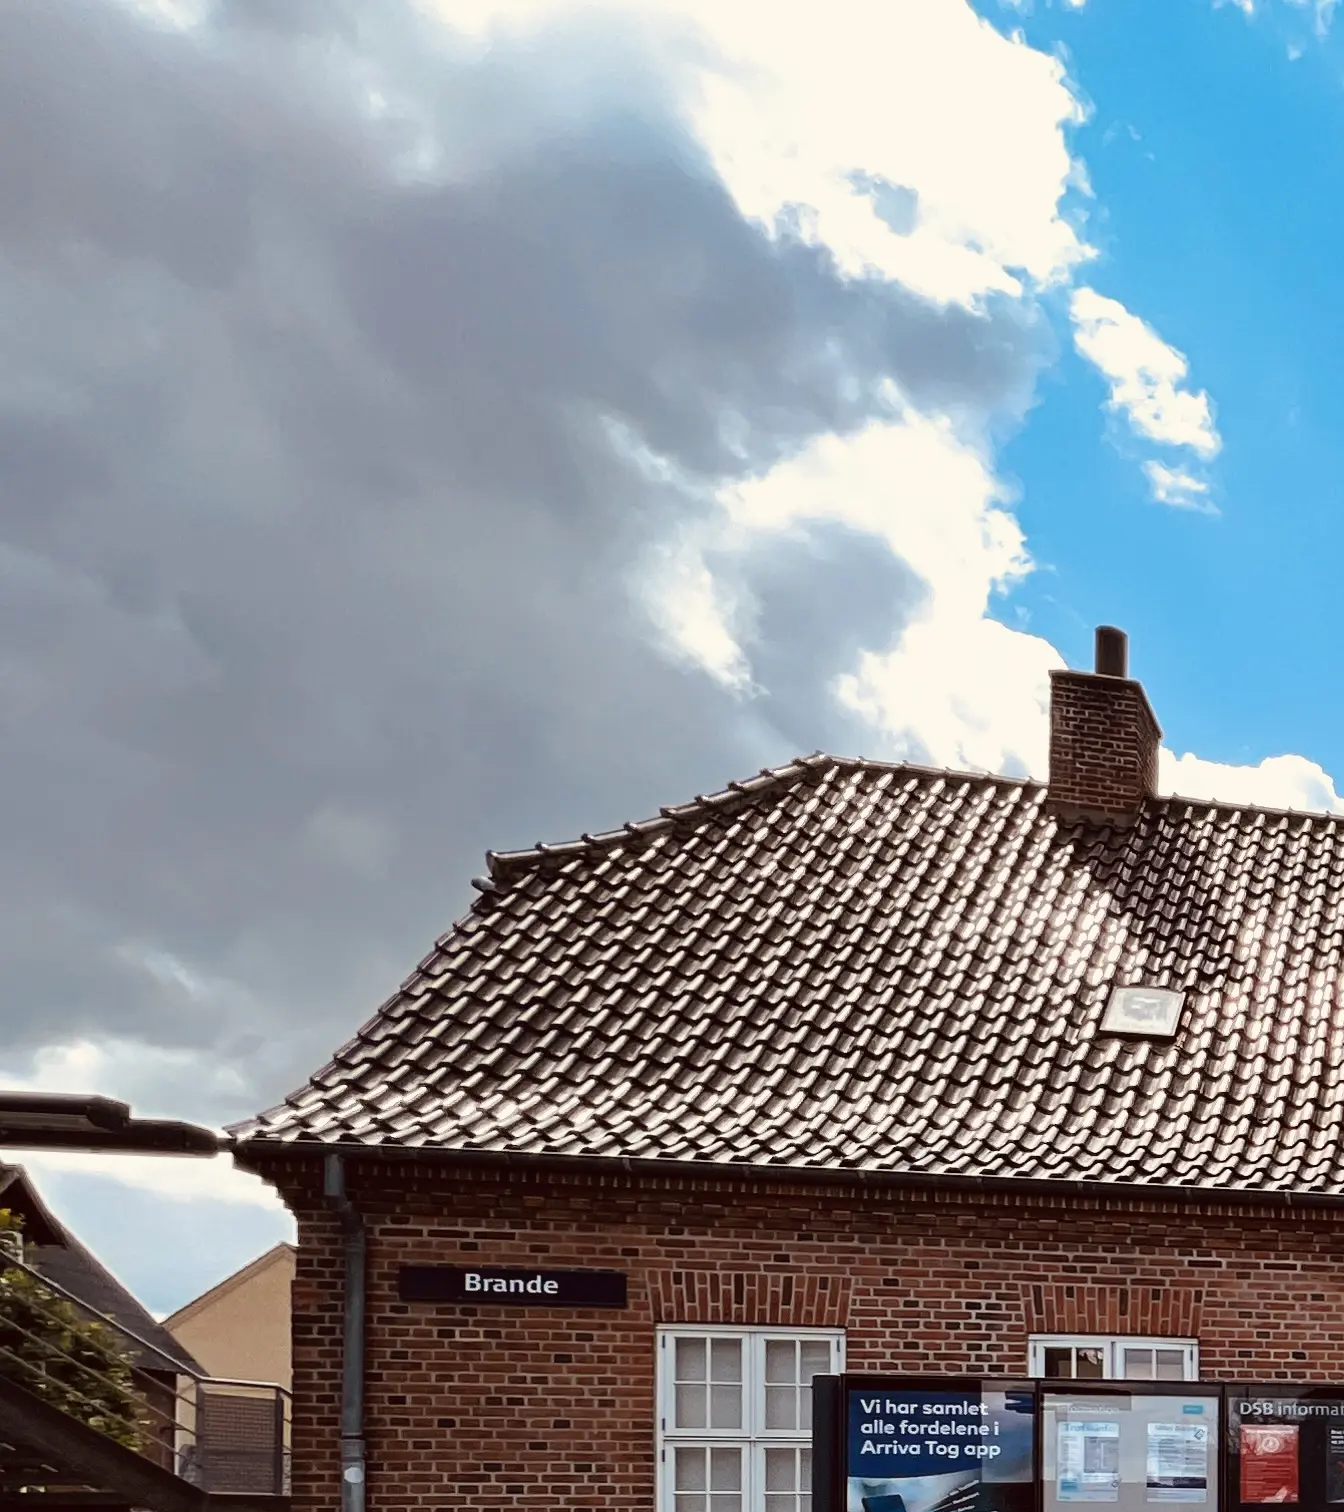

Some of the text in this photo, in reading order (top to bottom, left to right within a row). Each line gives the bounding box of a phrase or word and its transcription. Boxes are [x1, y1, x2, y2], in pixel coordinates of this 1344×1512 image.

[463, 1273, 560, 1294] Brande
[860, 1399, 989, 1416] Vi har samlet
[1240, 1402, 1274, 1416] DSB
[860, 1419, 1000, 1436] alle fordelene i
[860, 1440, 1002, 1459] Arriva Tog app
